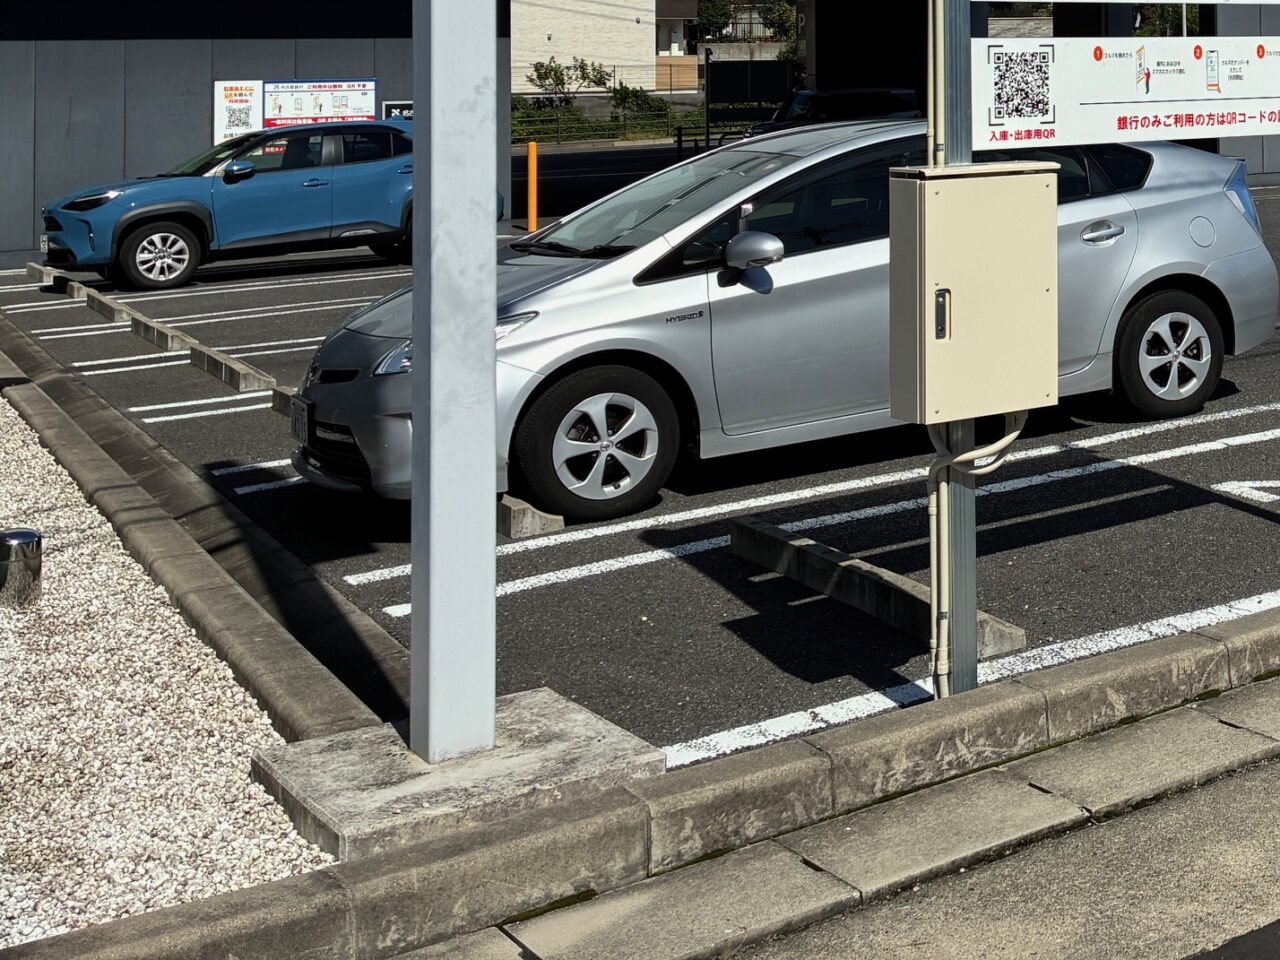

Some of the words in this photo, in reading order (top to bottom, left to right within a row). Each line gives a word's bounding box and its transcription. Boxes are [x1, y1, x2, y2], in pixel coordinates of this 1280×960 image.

[989, 128, 1056, 142] 入庫・出庫用QR
